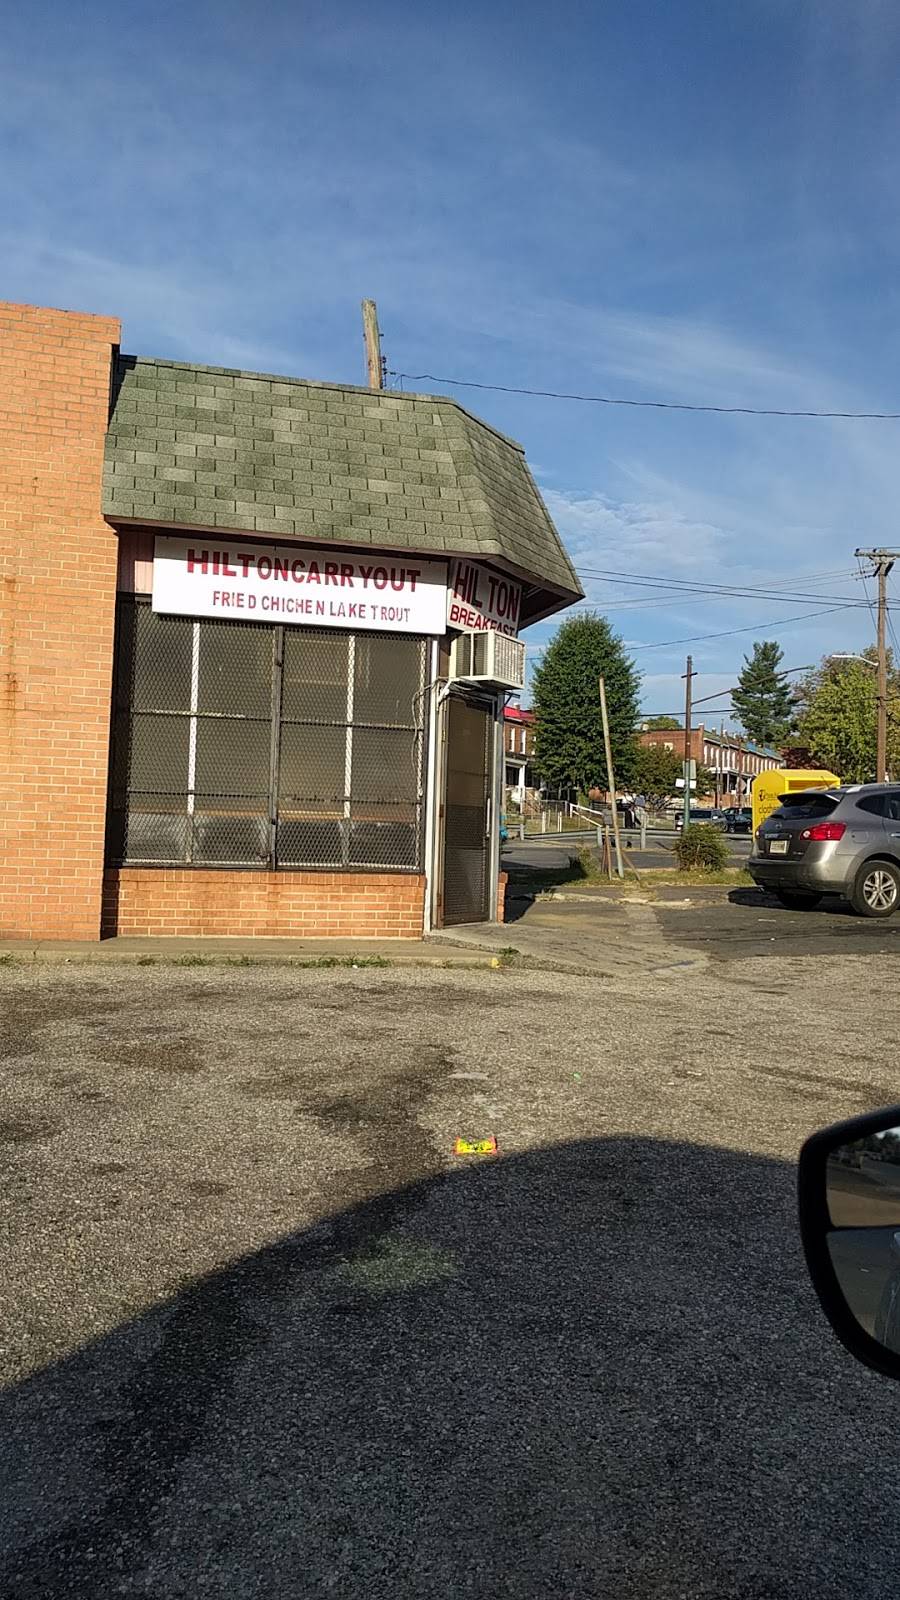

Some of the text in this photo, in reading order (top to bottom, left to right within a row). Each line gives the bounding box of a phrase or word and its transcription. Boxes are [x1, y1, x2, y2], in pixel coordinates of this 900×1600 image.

[212, 591, 410, 622] FRIED CHICHEN LAKE TROUT
